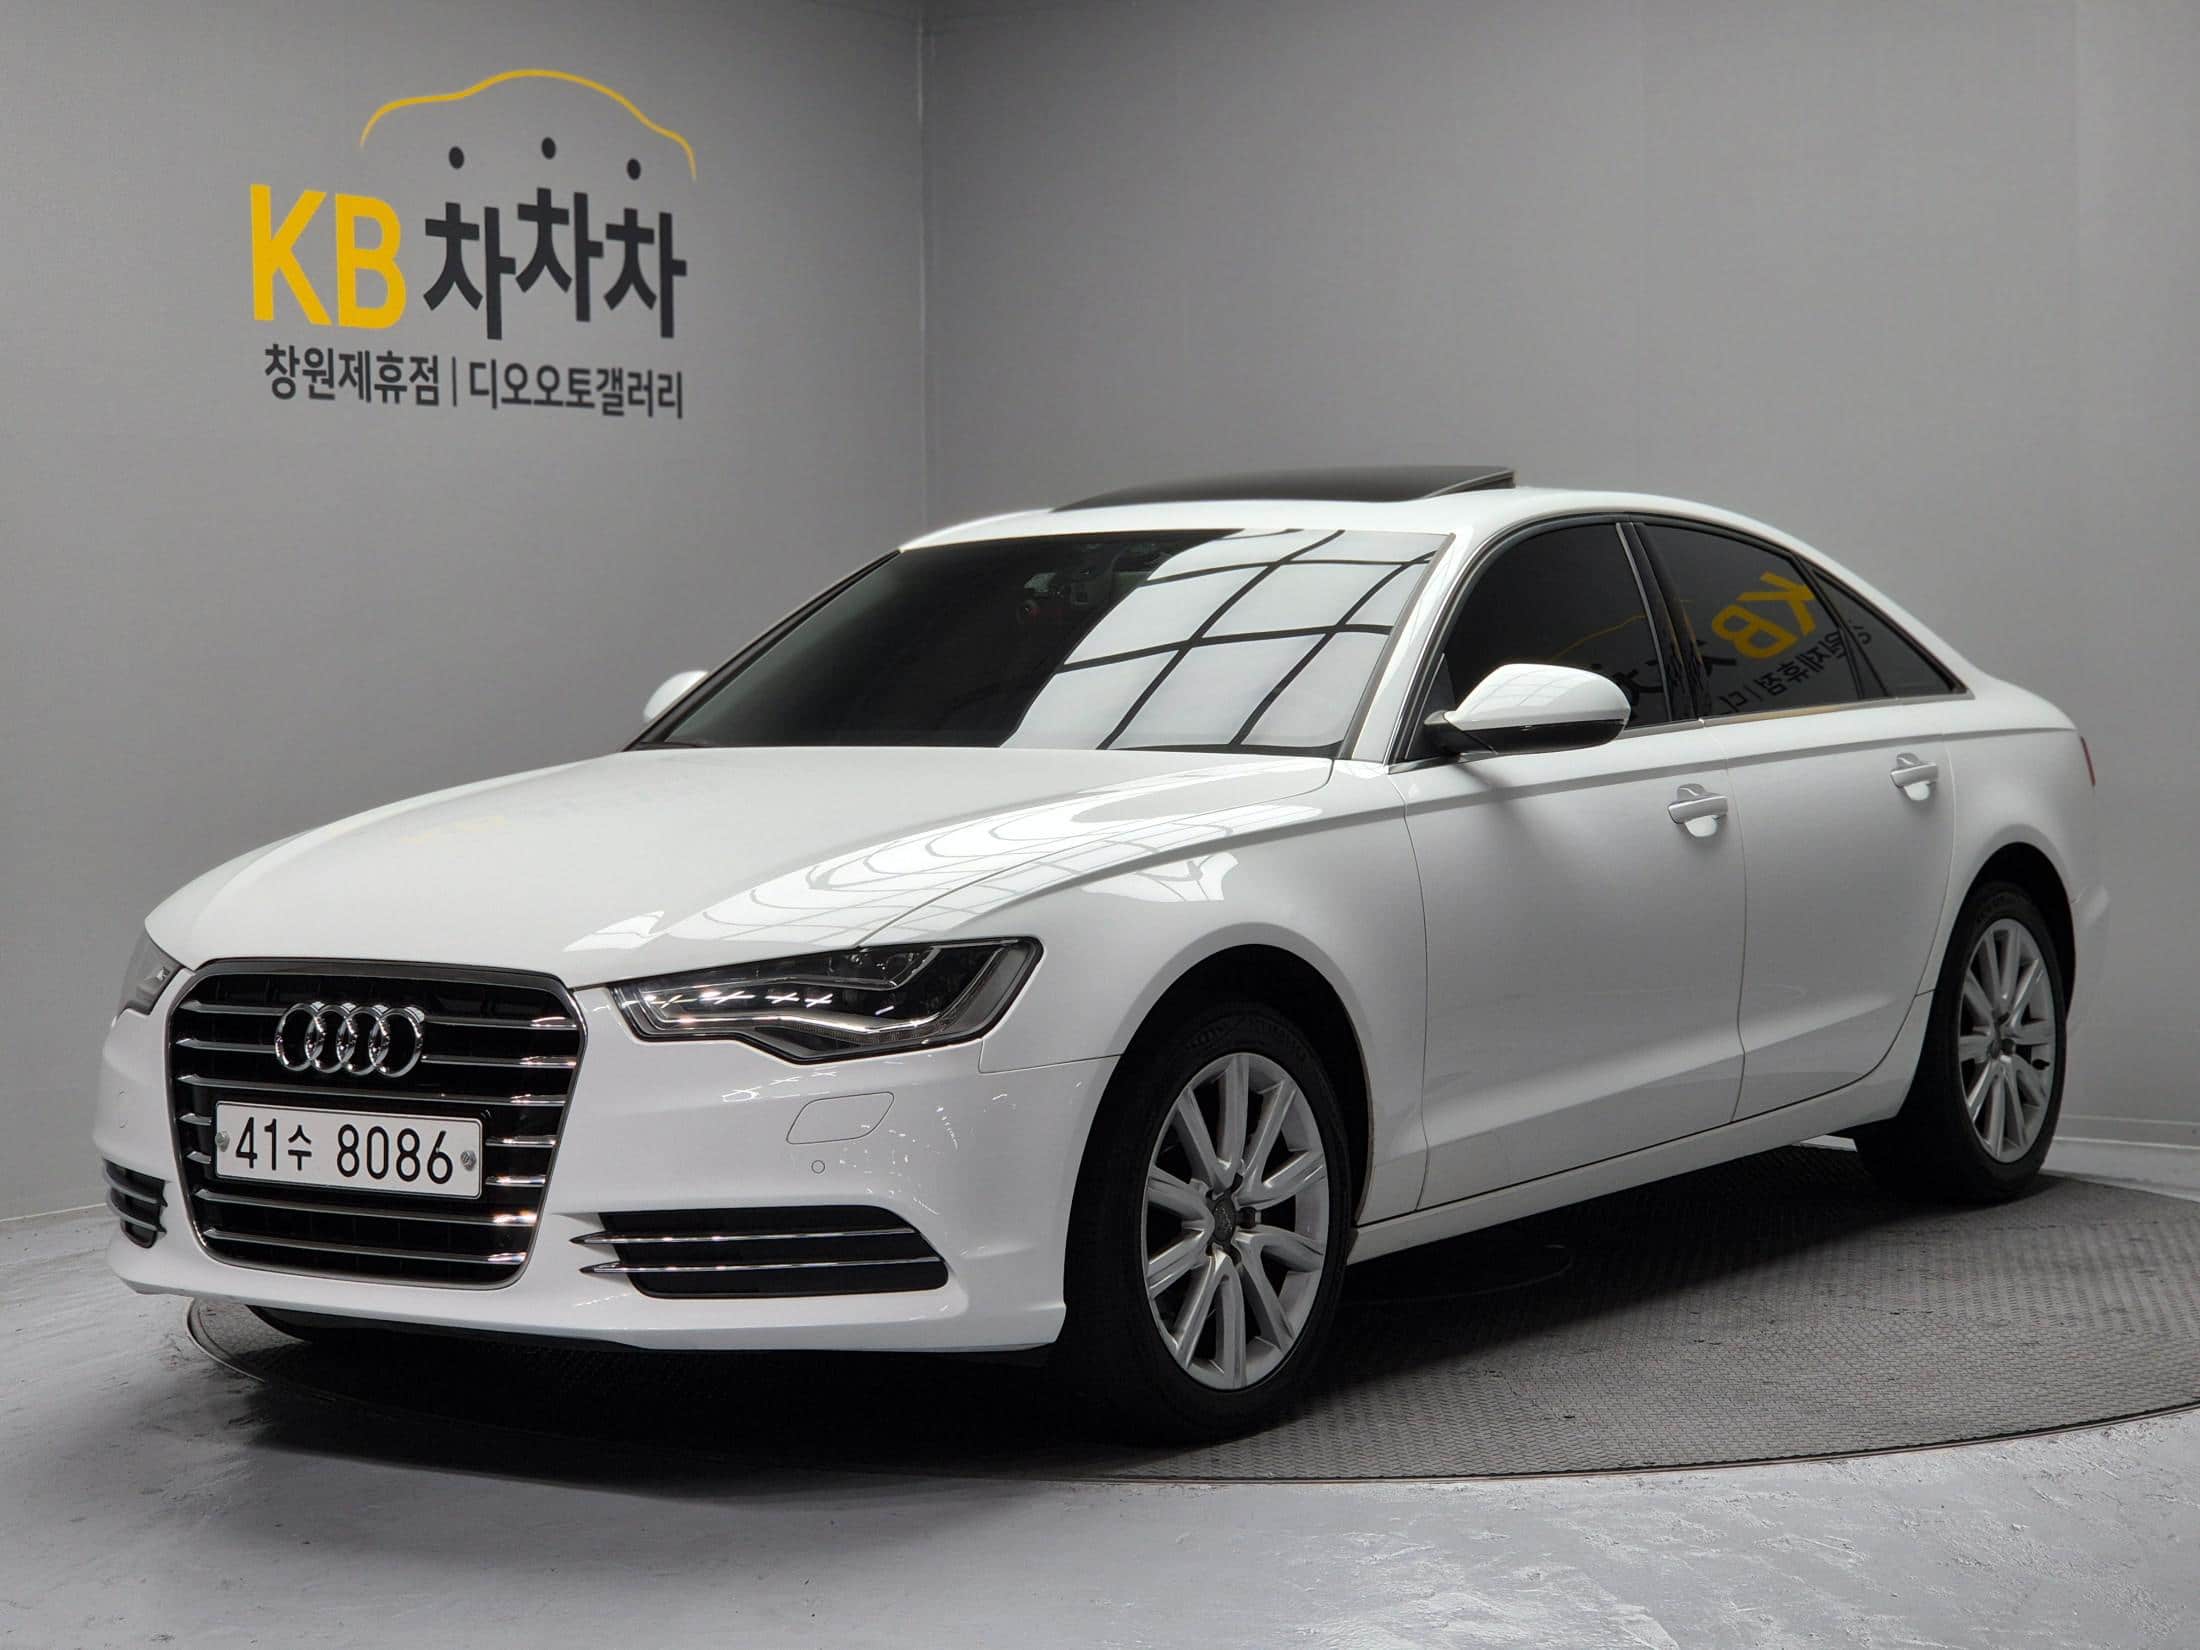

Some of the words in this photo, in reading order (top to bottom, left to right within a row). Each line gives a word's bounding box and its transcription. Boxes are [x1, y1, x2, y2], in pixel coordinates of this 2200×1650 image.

[250, 184, 407, 329] KB
[423, 187, 687, 340] 차차차
[265, 343, 439, 407] 창원제휴점
[469, 359, 683, 420] 디오오토갤러리
[235, 1116, 312, 1171] 41수
[336, 1123, 453, 1185] 8086
